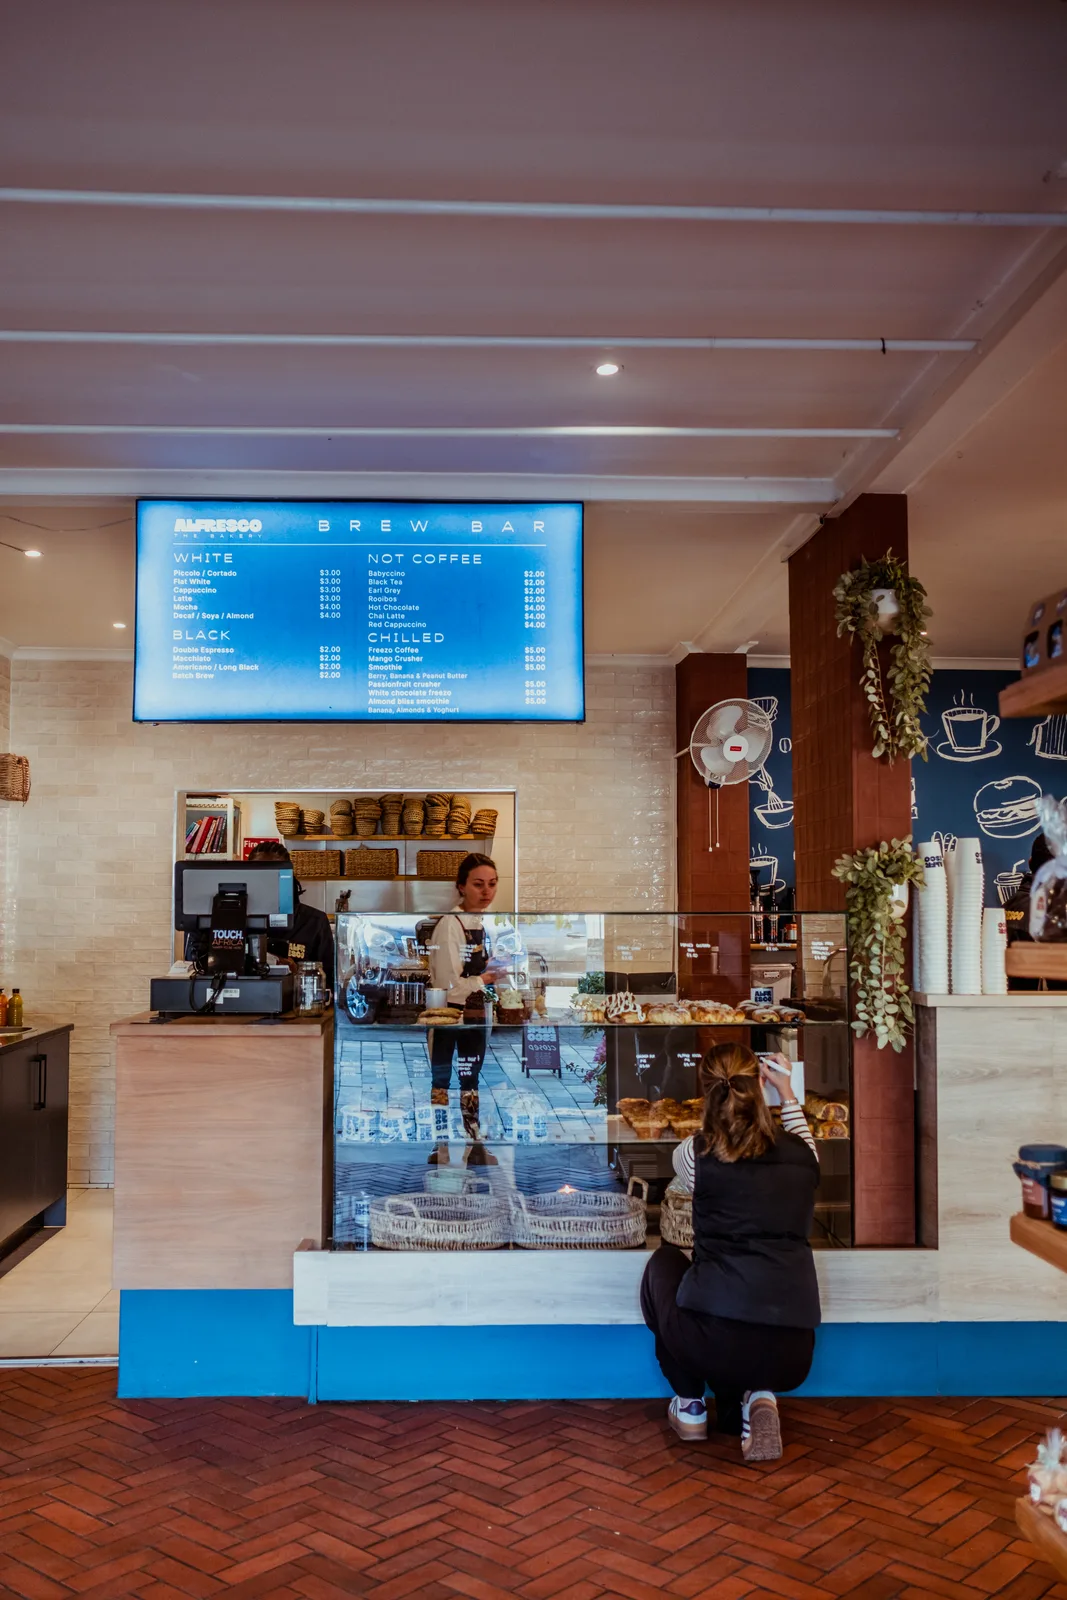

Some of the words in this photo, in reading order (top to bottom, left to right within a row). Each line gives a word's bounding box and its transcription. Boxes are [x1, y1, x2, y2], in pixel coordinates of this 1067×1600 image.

[174, 519, 262, 532] ALFRESCO
[318, 520, 428, 532] BREW
[472, 520, 544, 532] BAR
[174, 553, 233, 563] WHITE
[368, 554, 404, 564] NOT
[412, 554, 482, 564] COFFEE
[173, 630, 230, 640] BLACK
[368, 633, 444, 643] CHILLED
